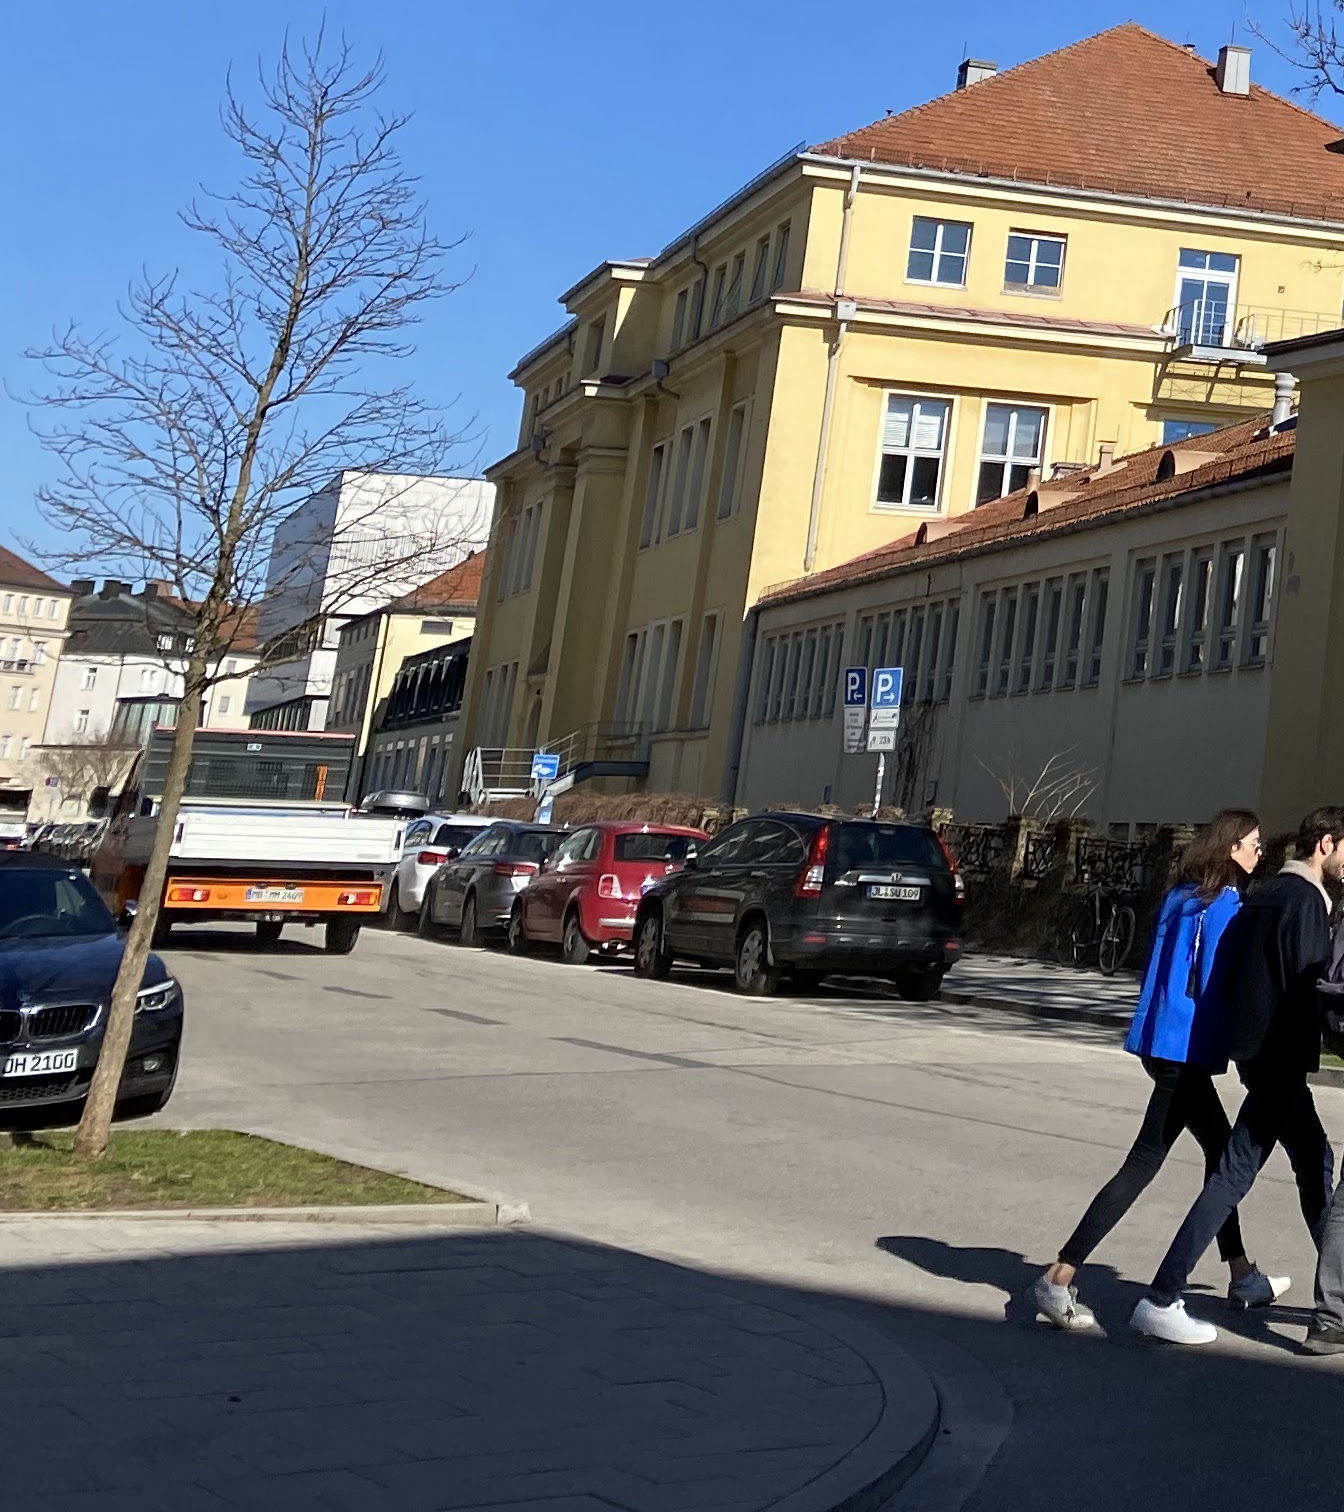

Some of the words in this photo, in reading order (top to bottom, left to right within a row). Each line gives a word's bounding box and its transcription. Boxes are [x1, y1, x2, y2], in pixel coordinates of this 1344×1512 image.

[848, 672, 860, 701] P
[876, 673, 893, 702] P
[30, 1052, 75, 1072] 2100
